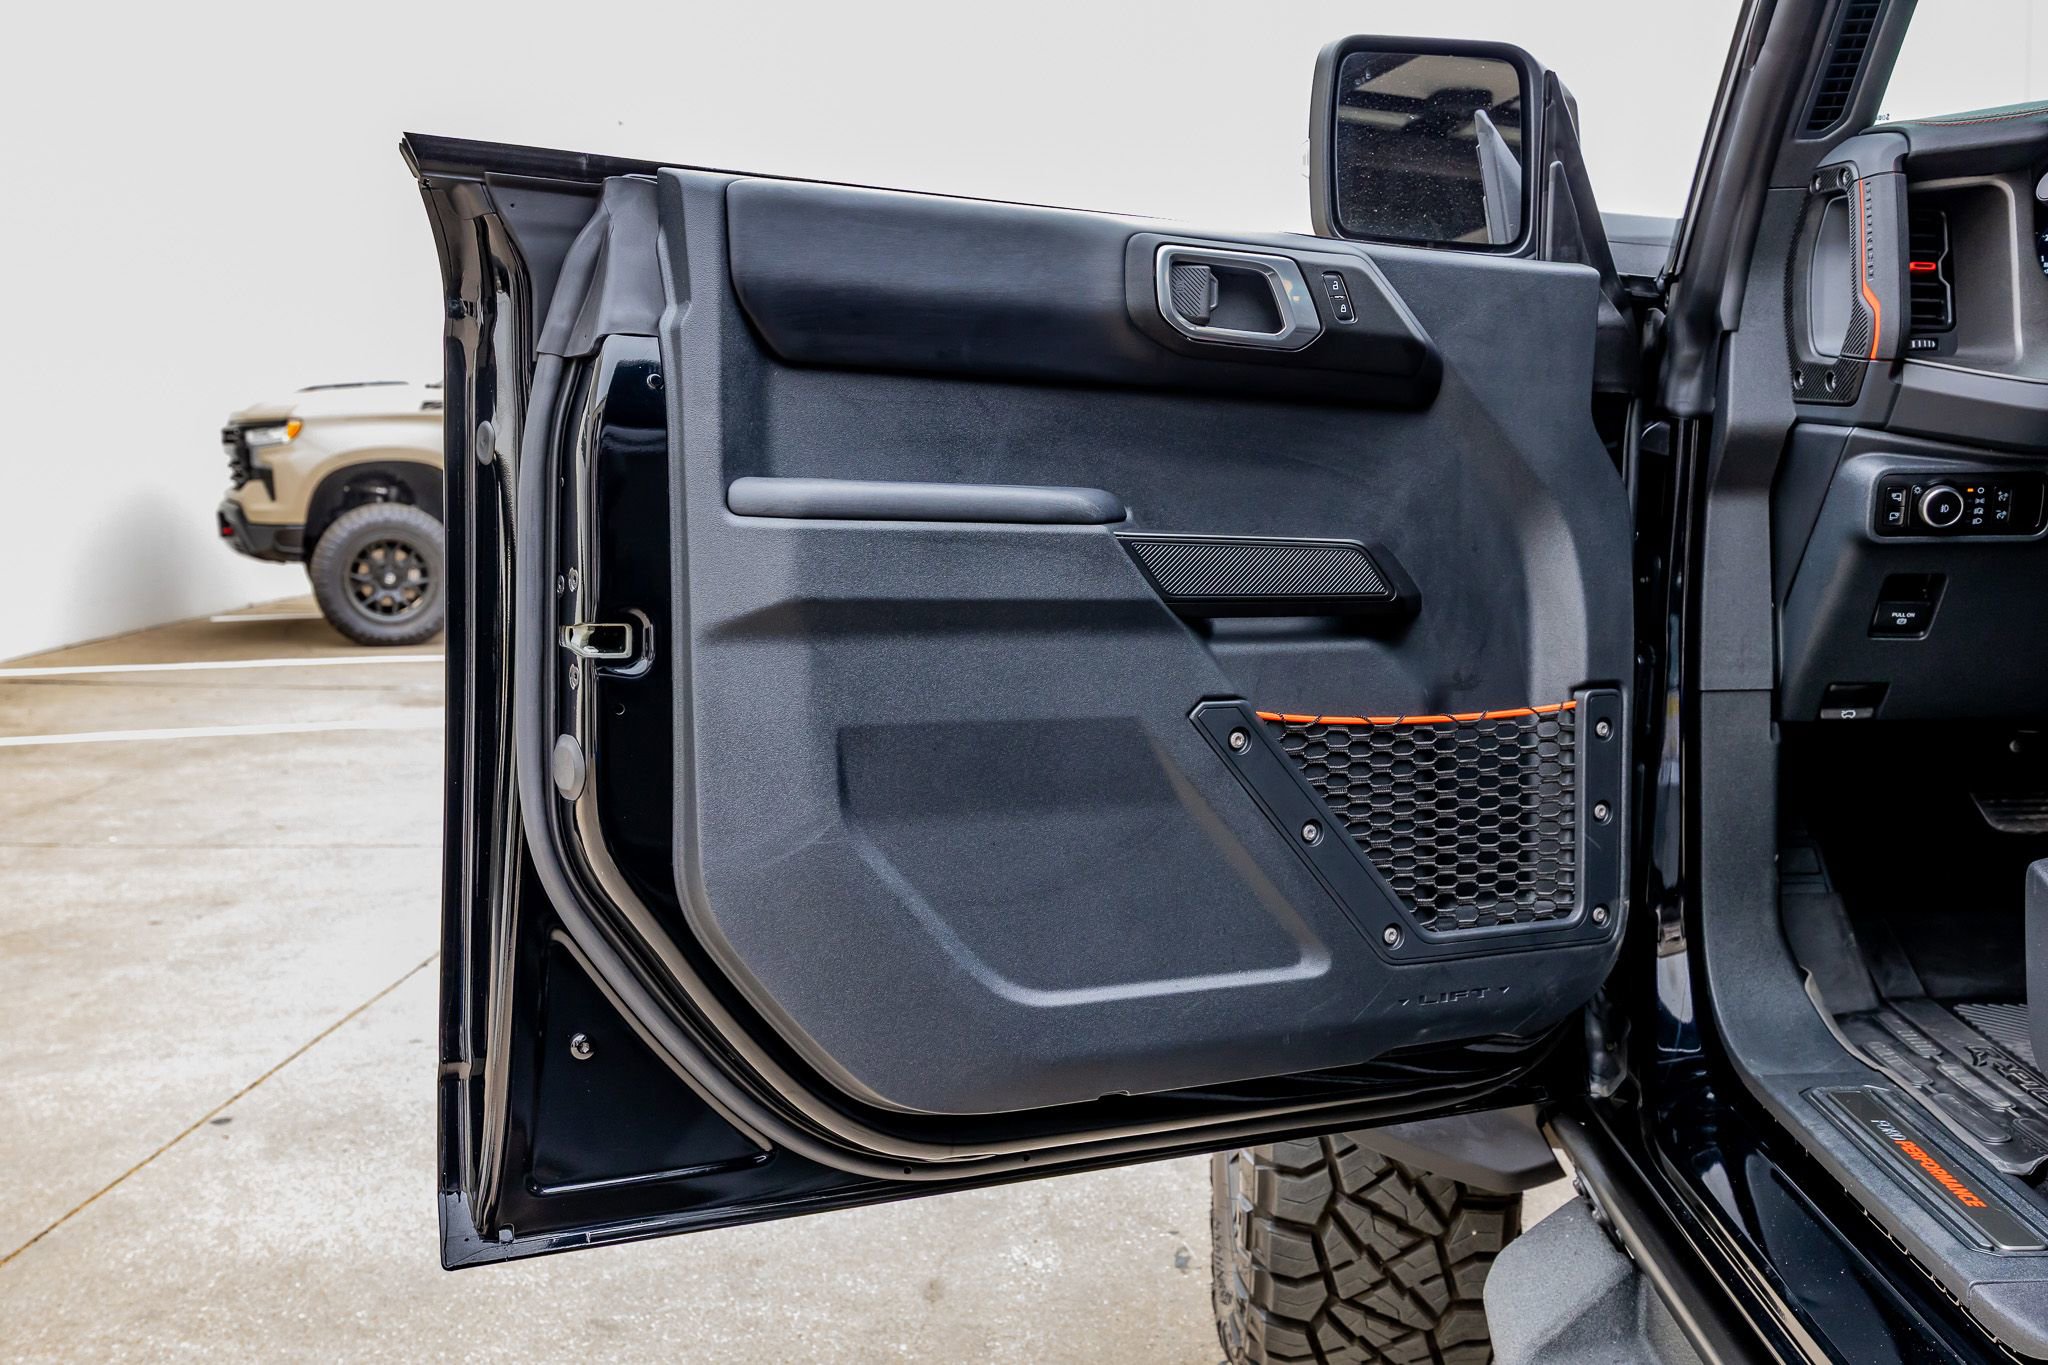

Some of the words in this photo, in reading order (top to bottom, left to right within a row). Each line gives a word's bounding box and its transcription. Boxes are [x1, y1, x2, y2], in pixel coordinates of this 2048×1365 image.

[1418, 987, 1491, 1006] LIFT
[1870, 1119, 1907, 1141] FORD
[1894, 1139, 1988, 1208] PERFORMANCE
